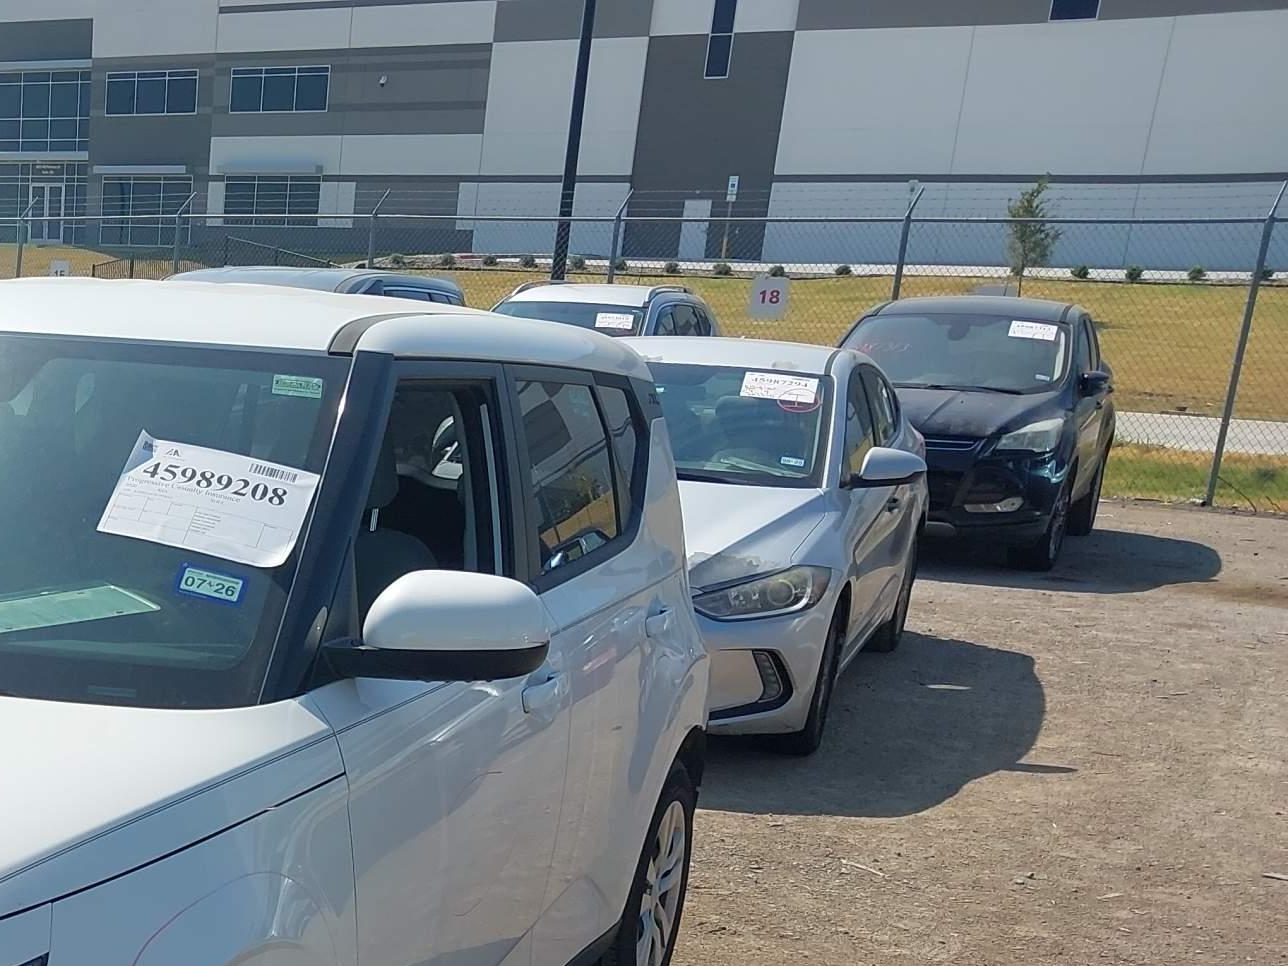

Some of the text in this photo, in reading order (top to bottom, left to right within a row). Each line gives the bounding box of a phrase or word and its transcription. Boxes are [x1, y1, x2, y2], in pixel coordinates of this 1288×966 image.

[759, 289, 780, 304] 18
[127, 475, 170, 488] Progressive
[171, 482, 203, 496] Casualty
[204, 488, 241, 503] Insurance
[143, 461, 288, 506] 45989208
[184, 575, 237, 597] 07 26
